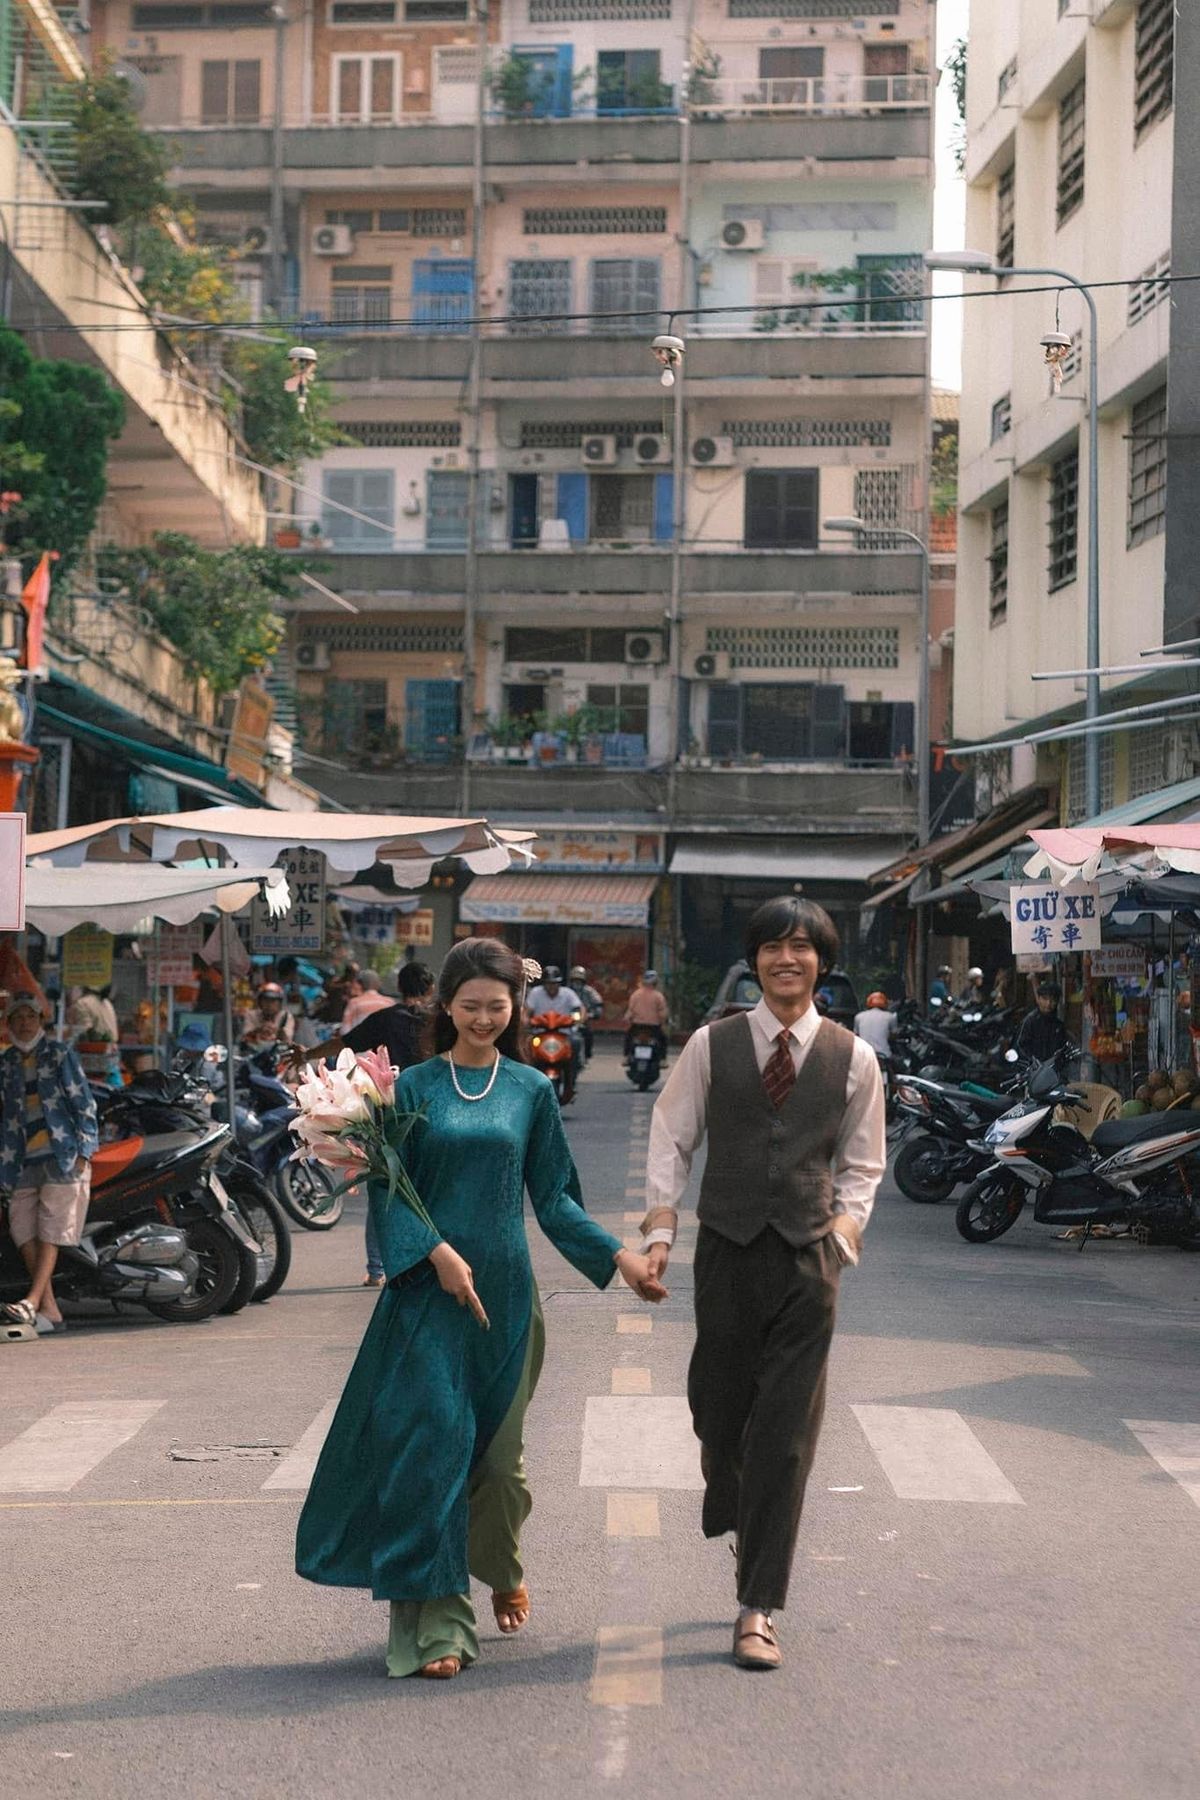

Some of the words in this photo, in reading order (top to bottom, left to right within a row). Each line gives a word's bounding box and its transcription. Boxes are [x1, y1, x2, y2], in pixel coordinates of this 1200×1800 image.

[296, 883, 319, 903] XE
[1016, 891, 1059, 922] GIỮ
[1064, 895, 1096, 919] XE
[1031, 923, 1082, 949] 寄車
